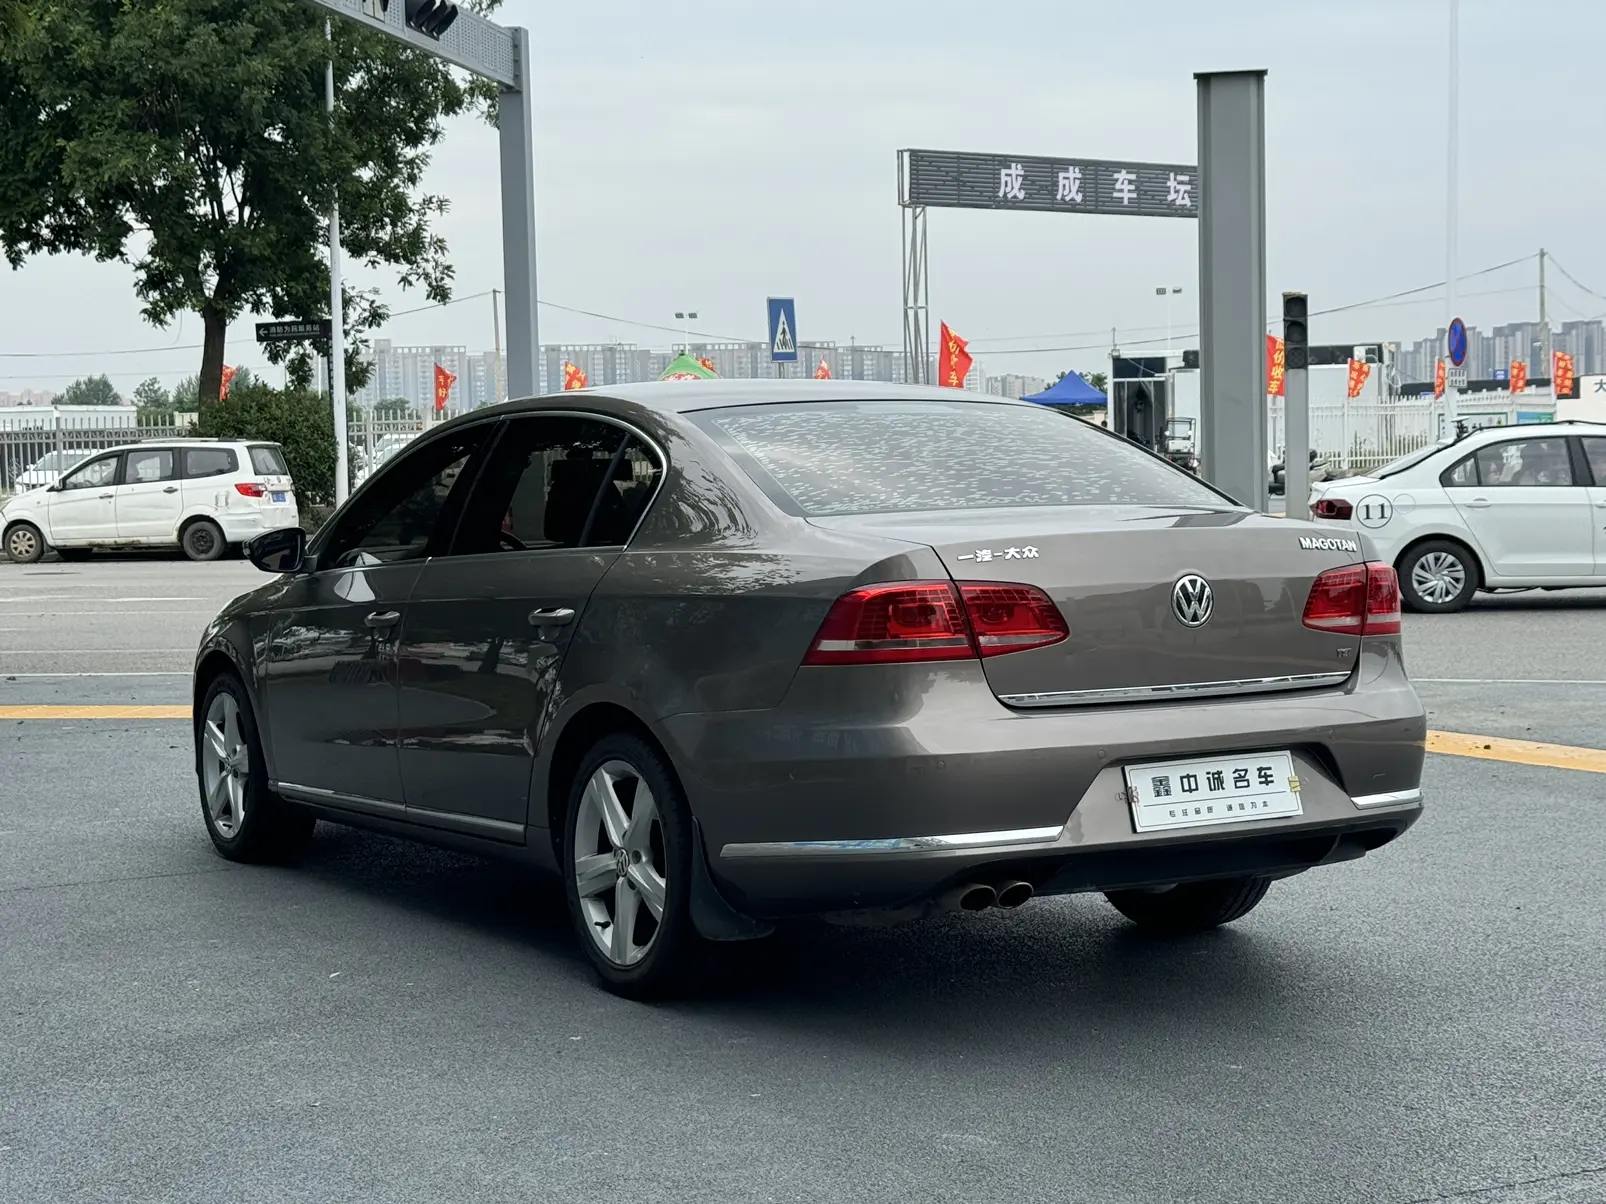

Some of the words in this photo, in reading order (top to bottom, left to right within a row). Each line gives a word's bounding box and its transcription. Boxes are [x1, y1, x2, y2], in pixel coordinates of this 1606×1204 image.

[998, 163, 1192, 207] 成成车坛
[1363, 503, 1388, 520] 11
[1299, 537, 1357, 551] MAGOTAN
[1151, 766, 1274, 798] 鑫中诚名车
